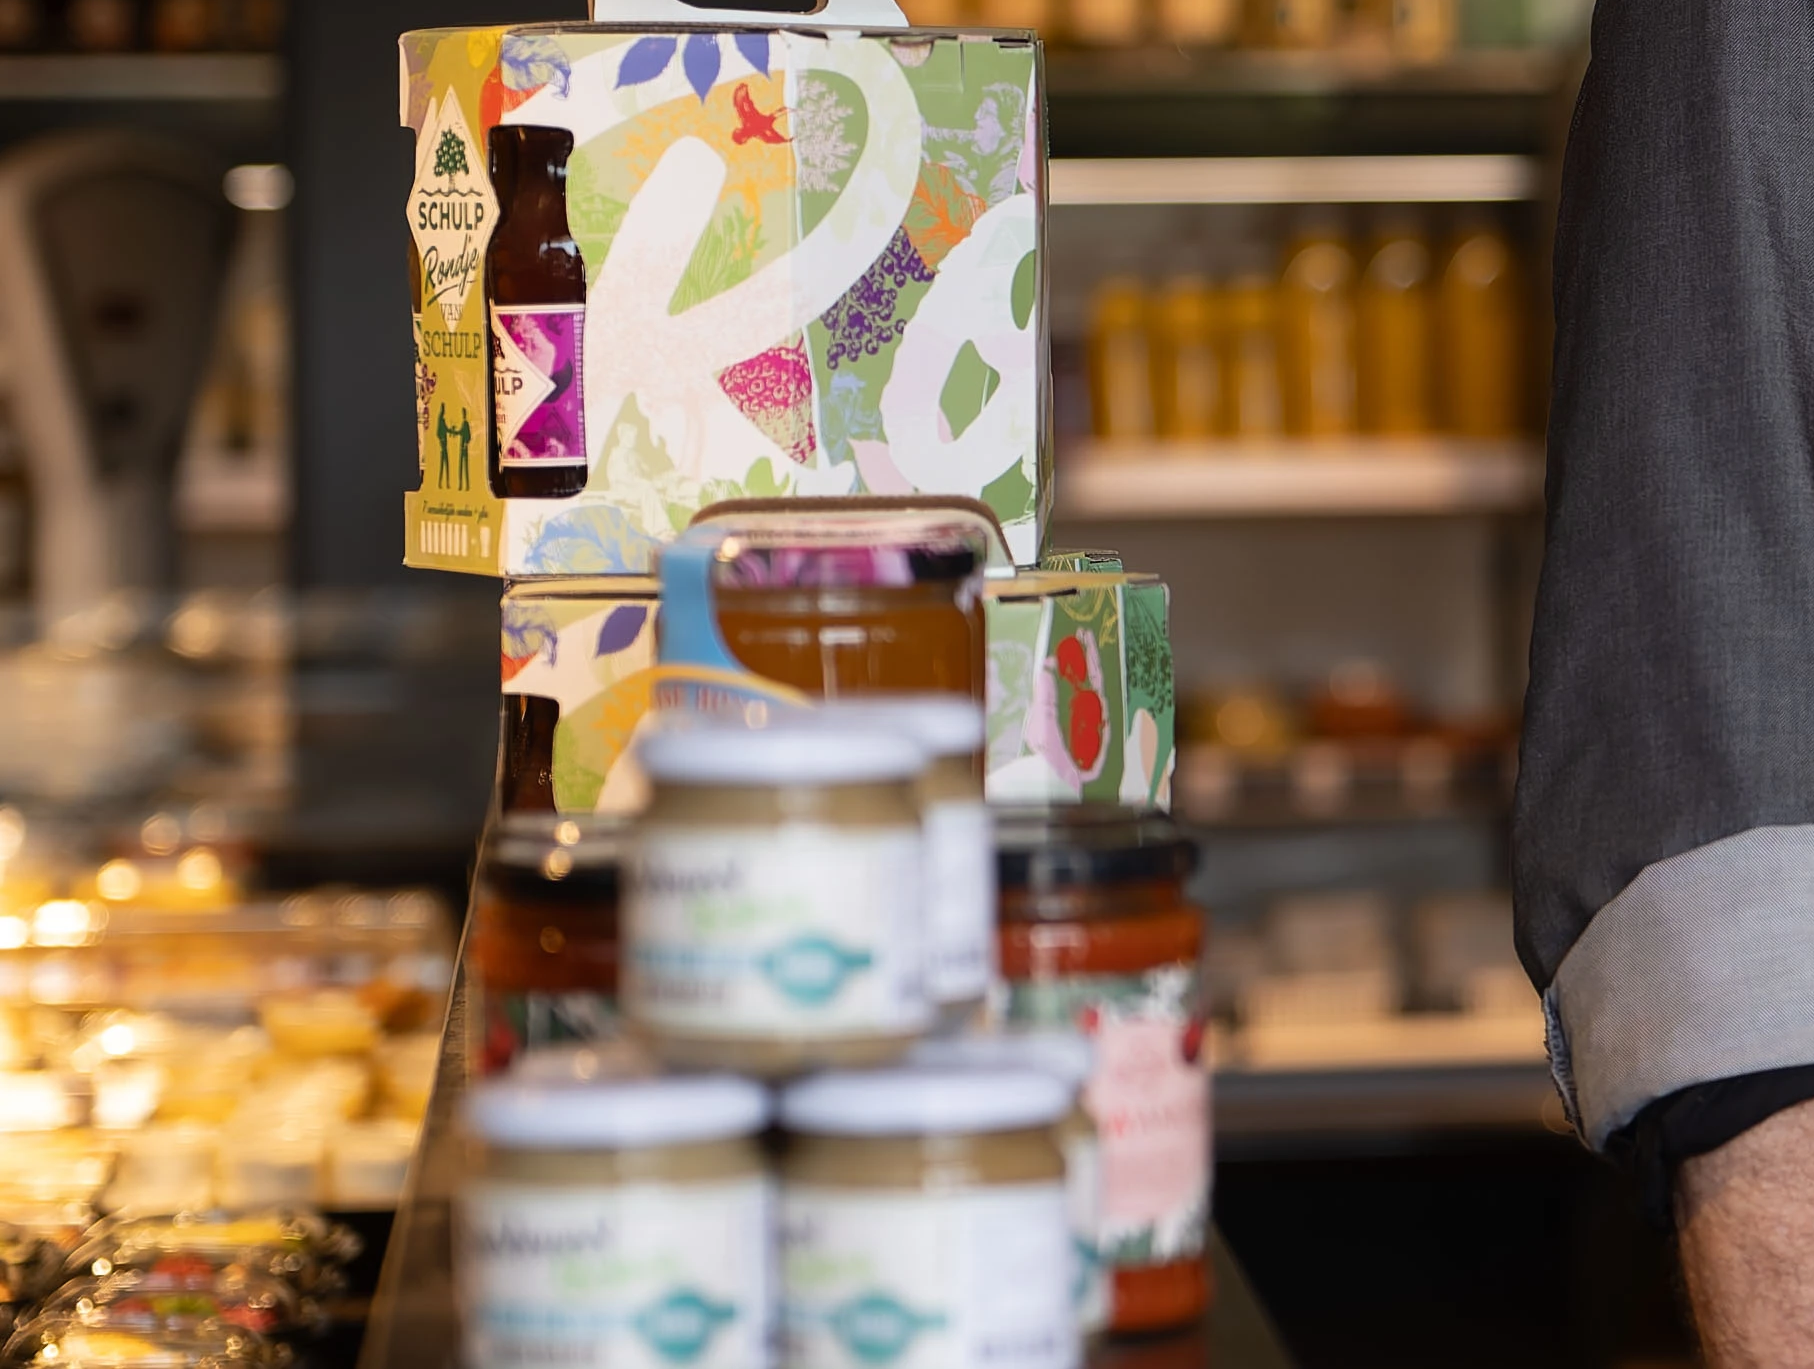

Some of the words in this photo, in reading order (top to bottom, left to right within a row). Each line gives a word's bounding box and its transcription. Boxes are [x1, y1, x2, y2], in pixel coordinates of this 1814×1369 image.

[418, 202, 484, 230] SCHULP
[423, 233, 480, 297] Rondje
[440, 303, 463, 321] VAN
[423, 331, 481, 359] SCHULP
